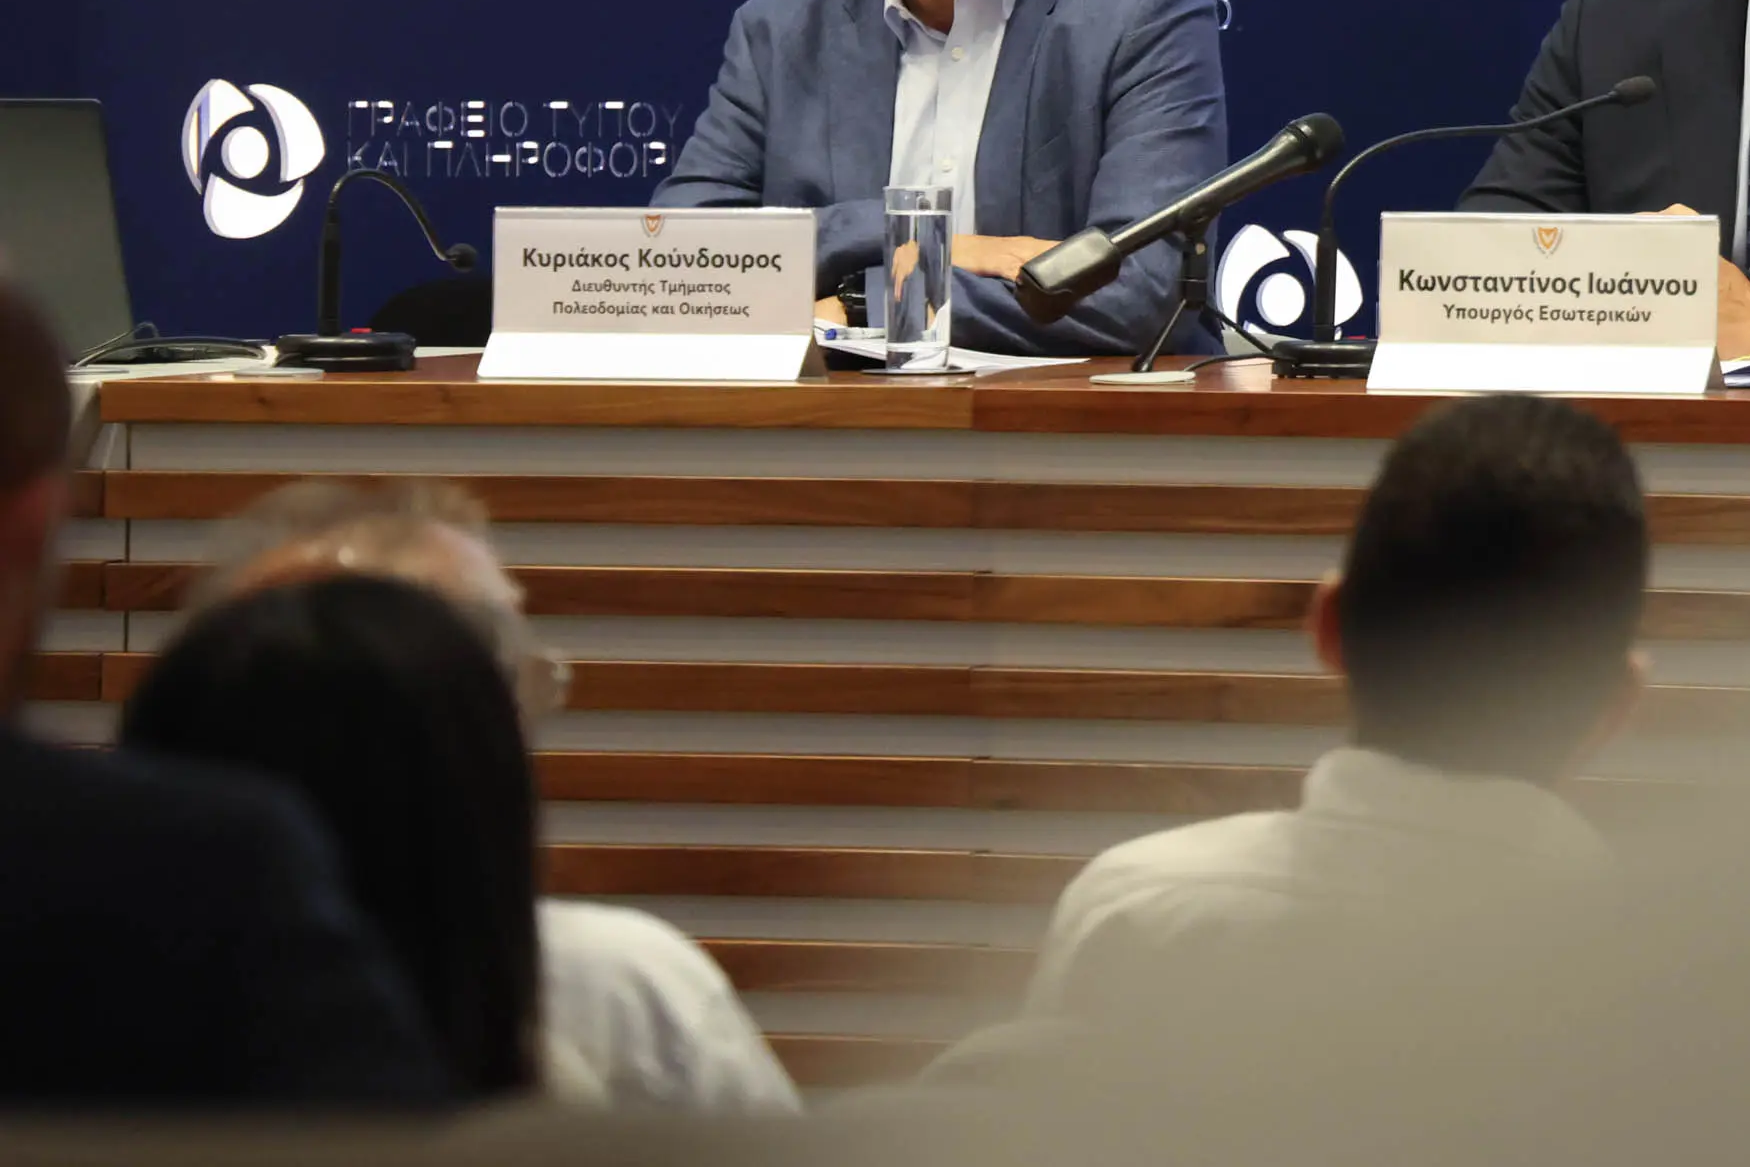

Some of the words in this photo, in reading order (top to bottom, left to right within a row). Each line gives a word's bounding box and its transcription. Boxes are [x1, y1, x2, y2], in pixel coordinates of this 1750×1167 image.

[348, 100, 529, 137] ΓΡΑΦΕΙΟ
[542, 100, 685, 138] ΤΥΠΟΥ
[348, 141, 408, 178] ΚΑΙ
[522, 247, 630, 272] Κυριάκος
[637, 247, 783, 273] Κούνδουρος
[571, 279, 656, 296] Διευθυντής
[660, 279, 732, 296] Τμήματος
[1398, 269, 1582, 299] Κωνσταντίνος
[1588, 271, 1698, 297] Ιωάννου
[552, 300, 648, 318] Πολεοδομίας
[651, 304, 676, 316] και
[679, 301, 750, 318] Οικήσεως
[1442, 304, 1535, 325] Υπουργός
[1538, 305, 1652, 326] Εσωτερικών
